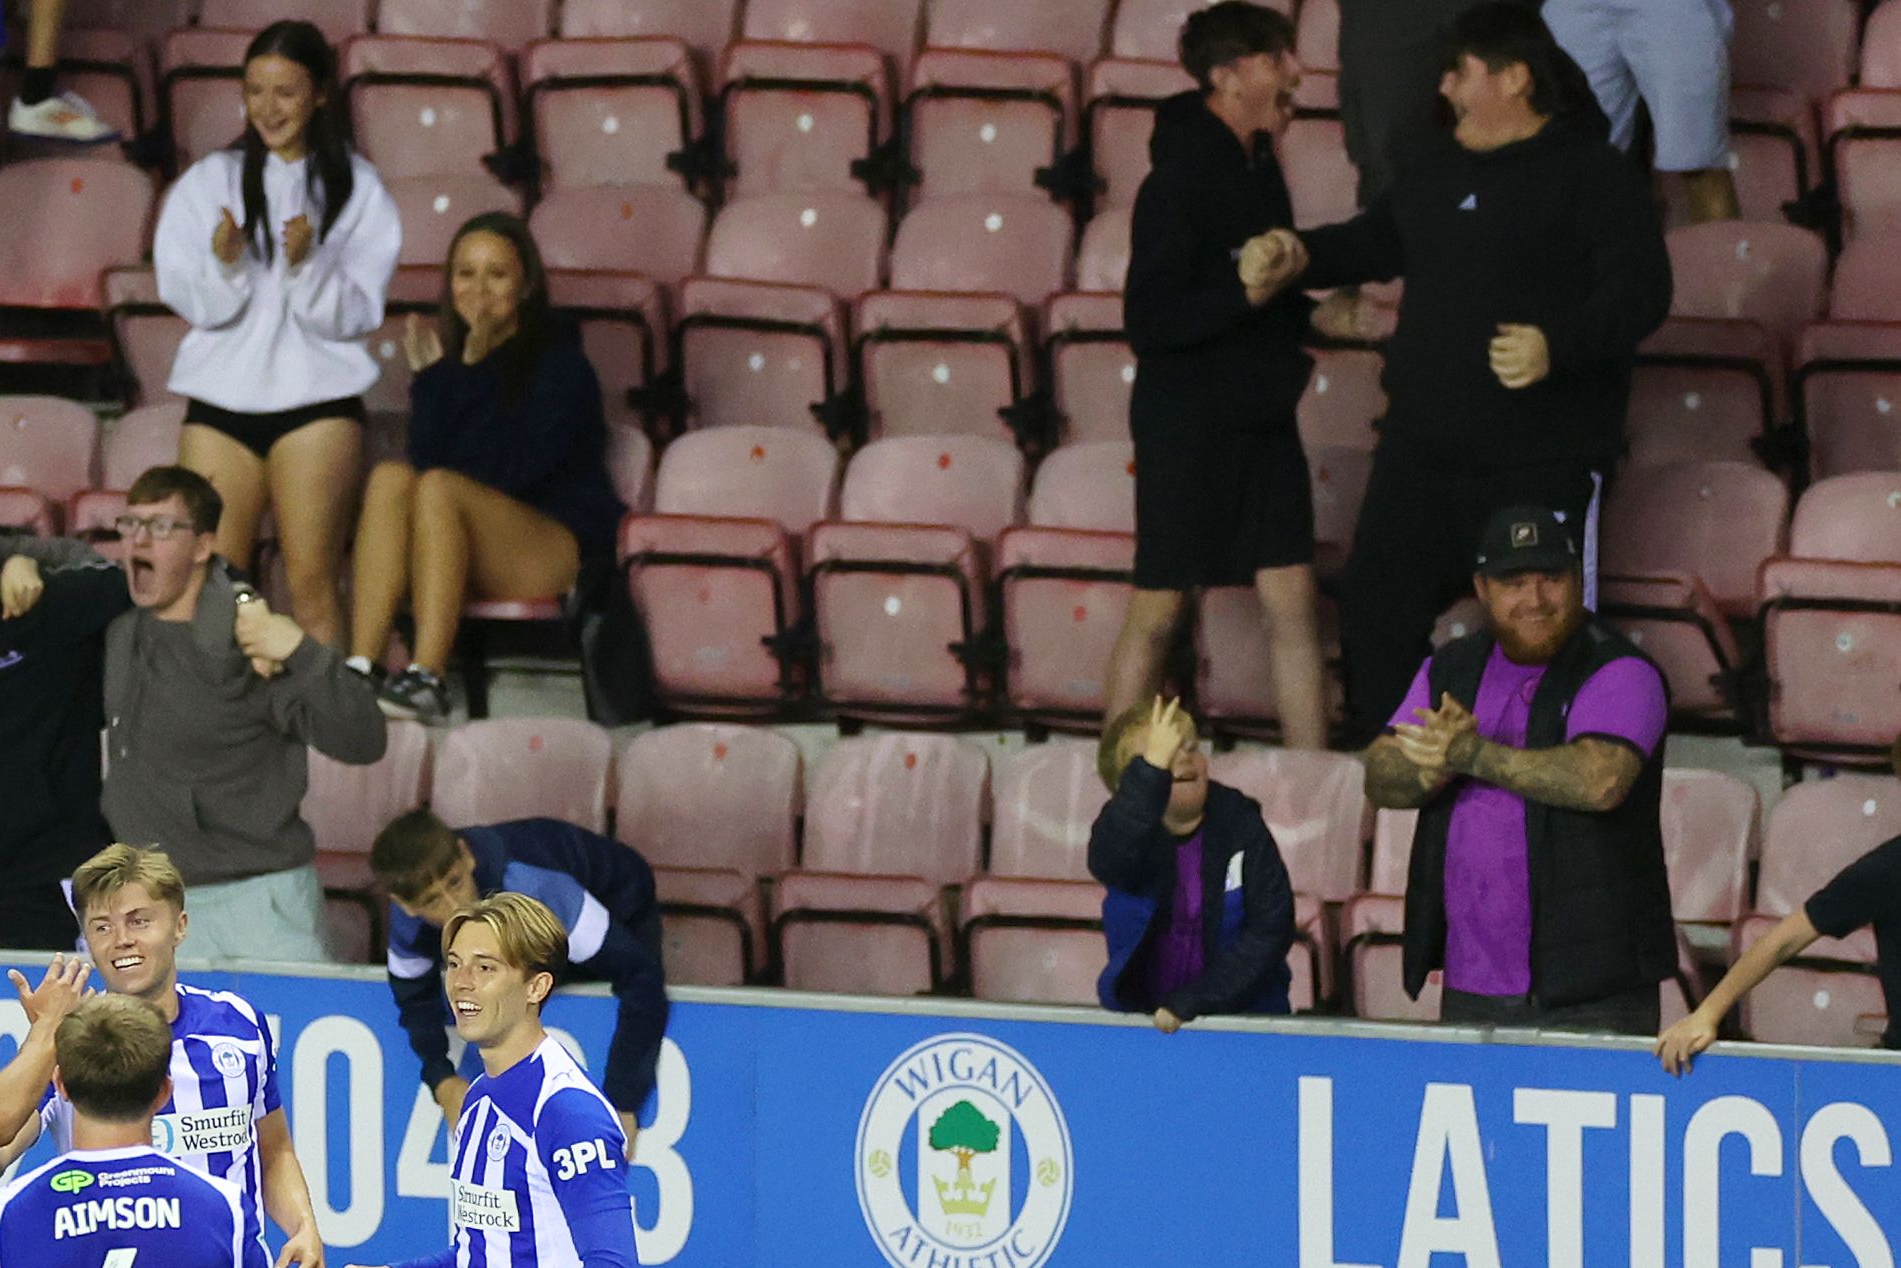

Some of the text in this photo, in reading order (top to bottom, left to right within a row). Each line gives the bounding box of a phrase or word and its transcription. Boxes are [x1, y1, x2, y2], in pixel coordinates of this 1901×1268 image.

[894, 1048, 1034, 1109] WIGAN
[181, 1110, 246, 1133] Smurfit
[553, 1139, 616, 1181] 3PL
[54, 1197, 181, 1240] AIMSON
